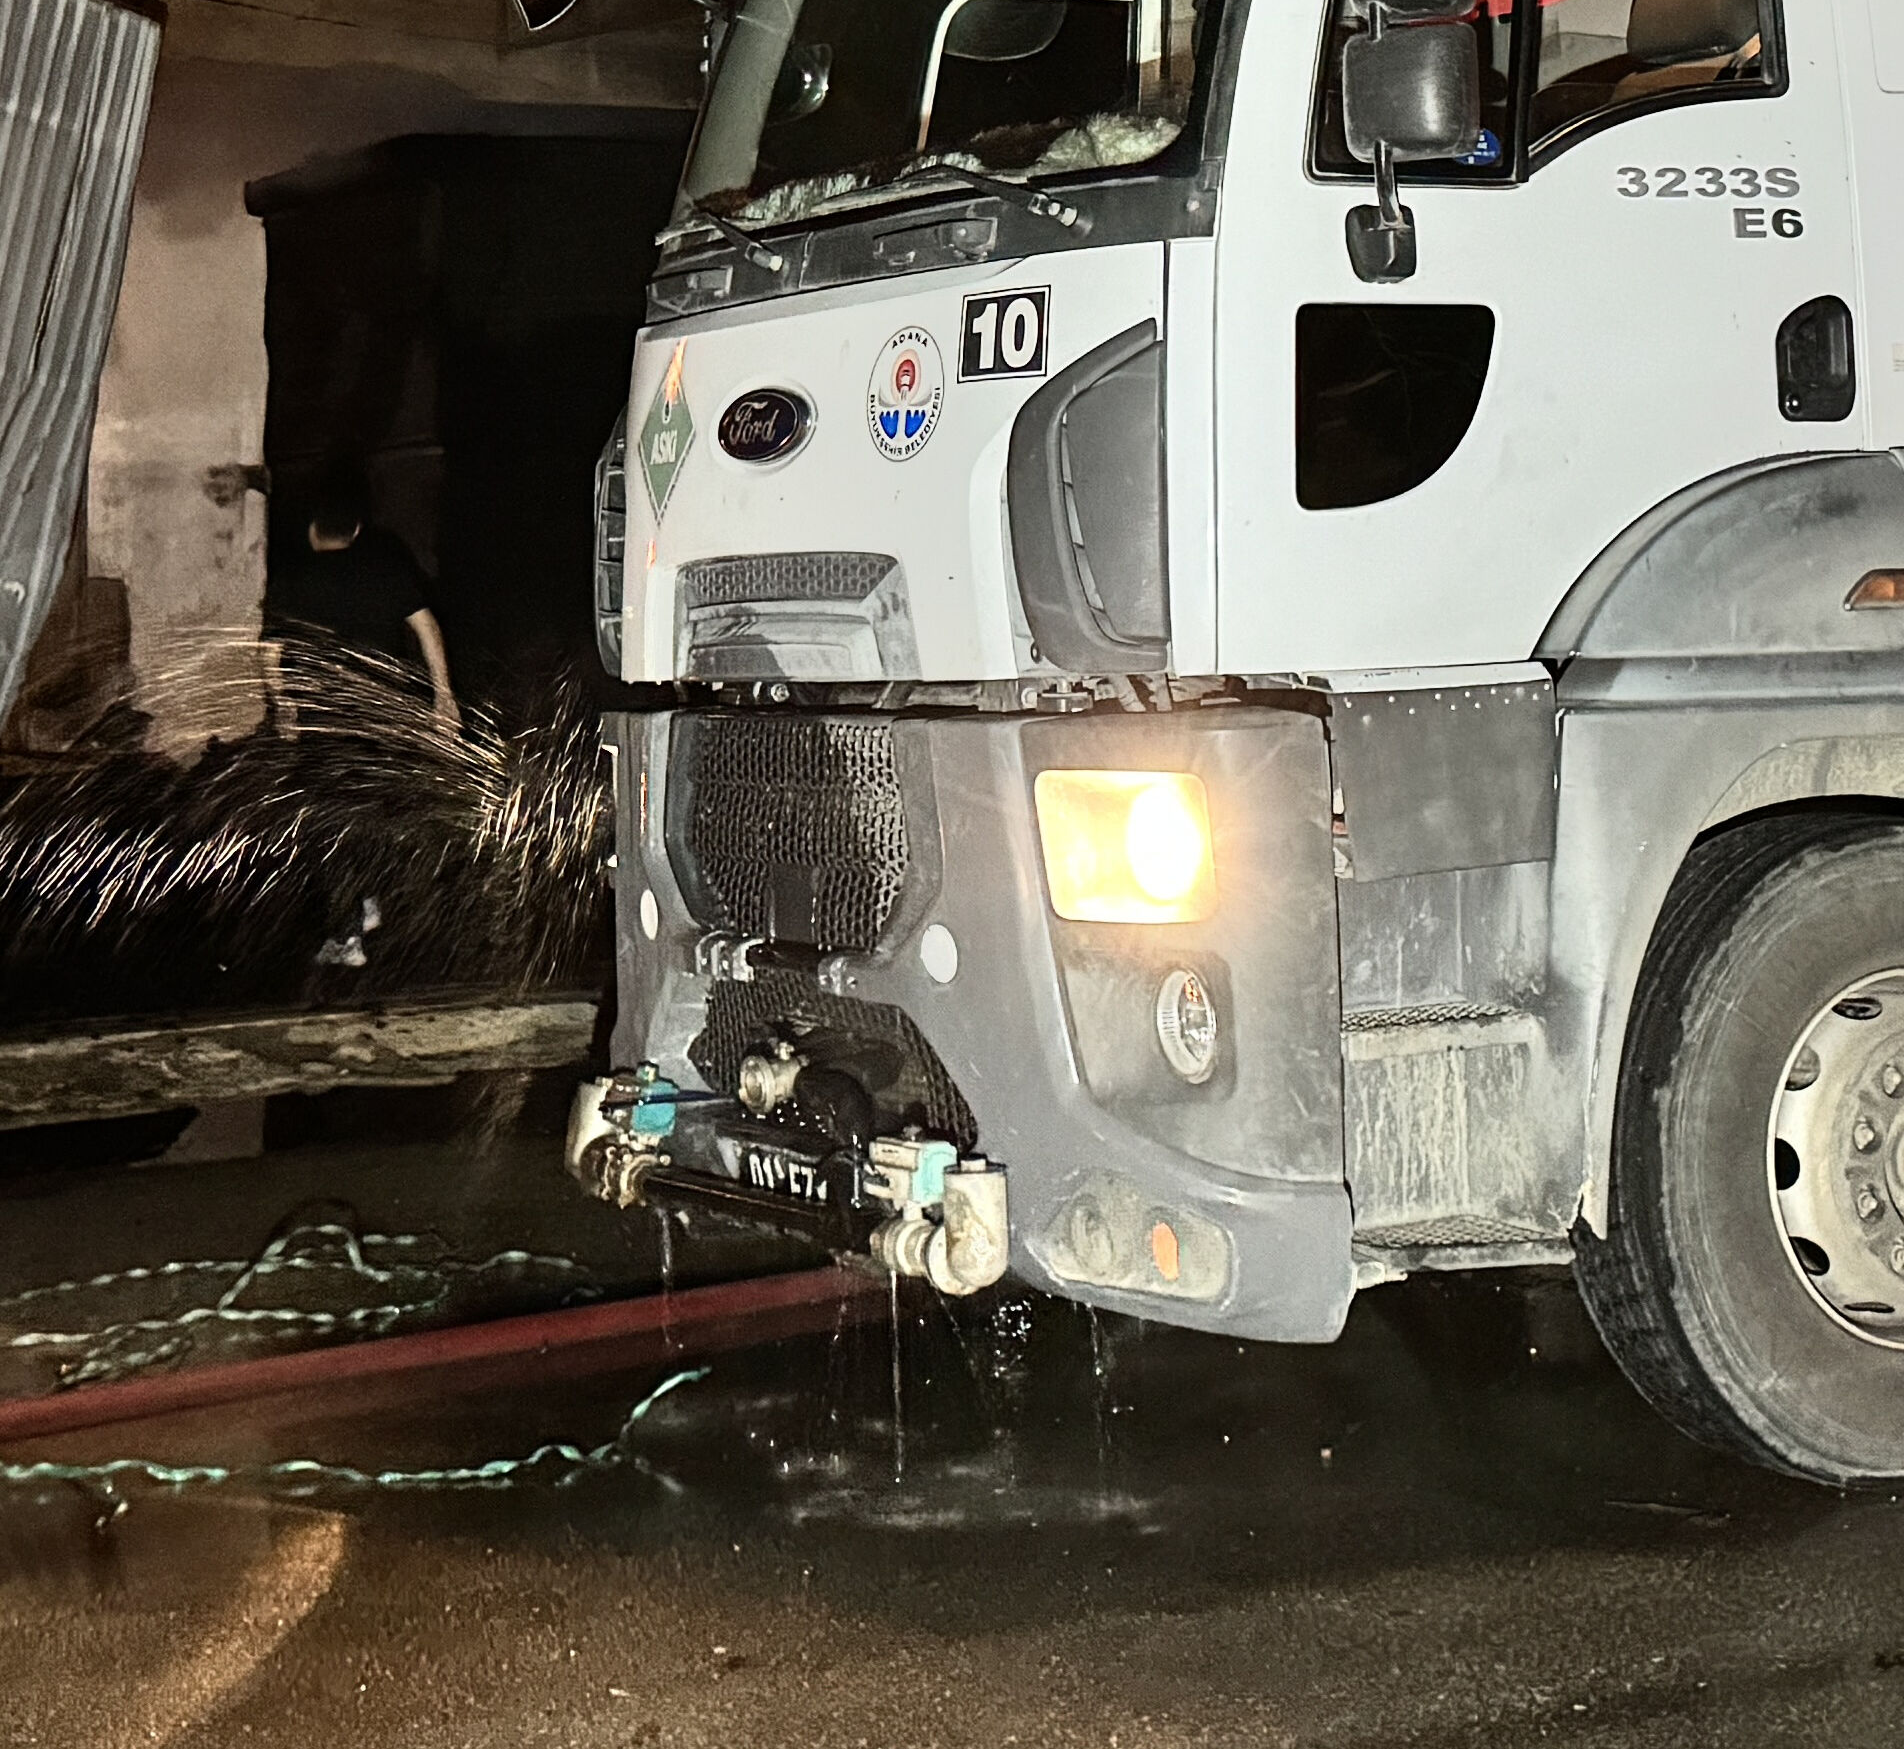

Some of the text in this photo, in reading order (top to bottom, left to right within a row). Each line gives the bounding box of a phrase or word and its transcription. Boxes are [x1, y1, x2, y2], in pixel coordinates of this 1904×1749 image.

[1616, 166, 1800, 198] 3233S
[1732, 207, 1804, 239] E6
[892, 332, 928, 350] ADANA
[972, 297, 1039, 369] 10
[729, 401, 779, 445] Ford
